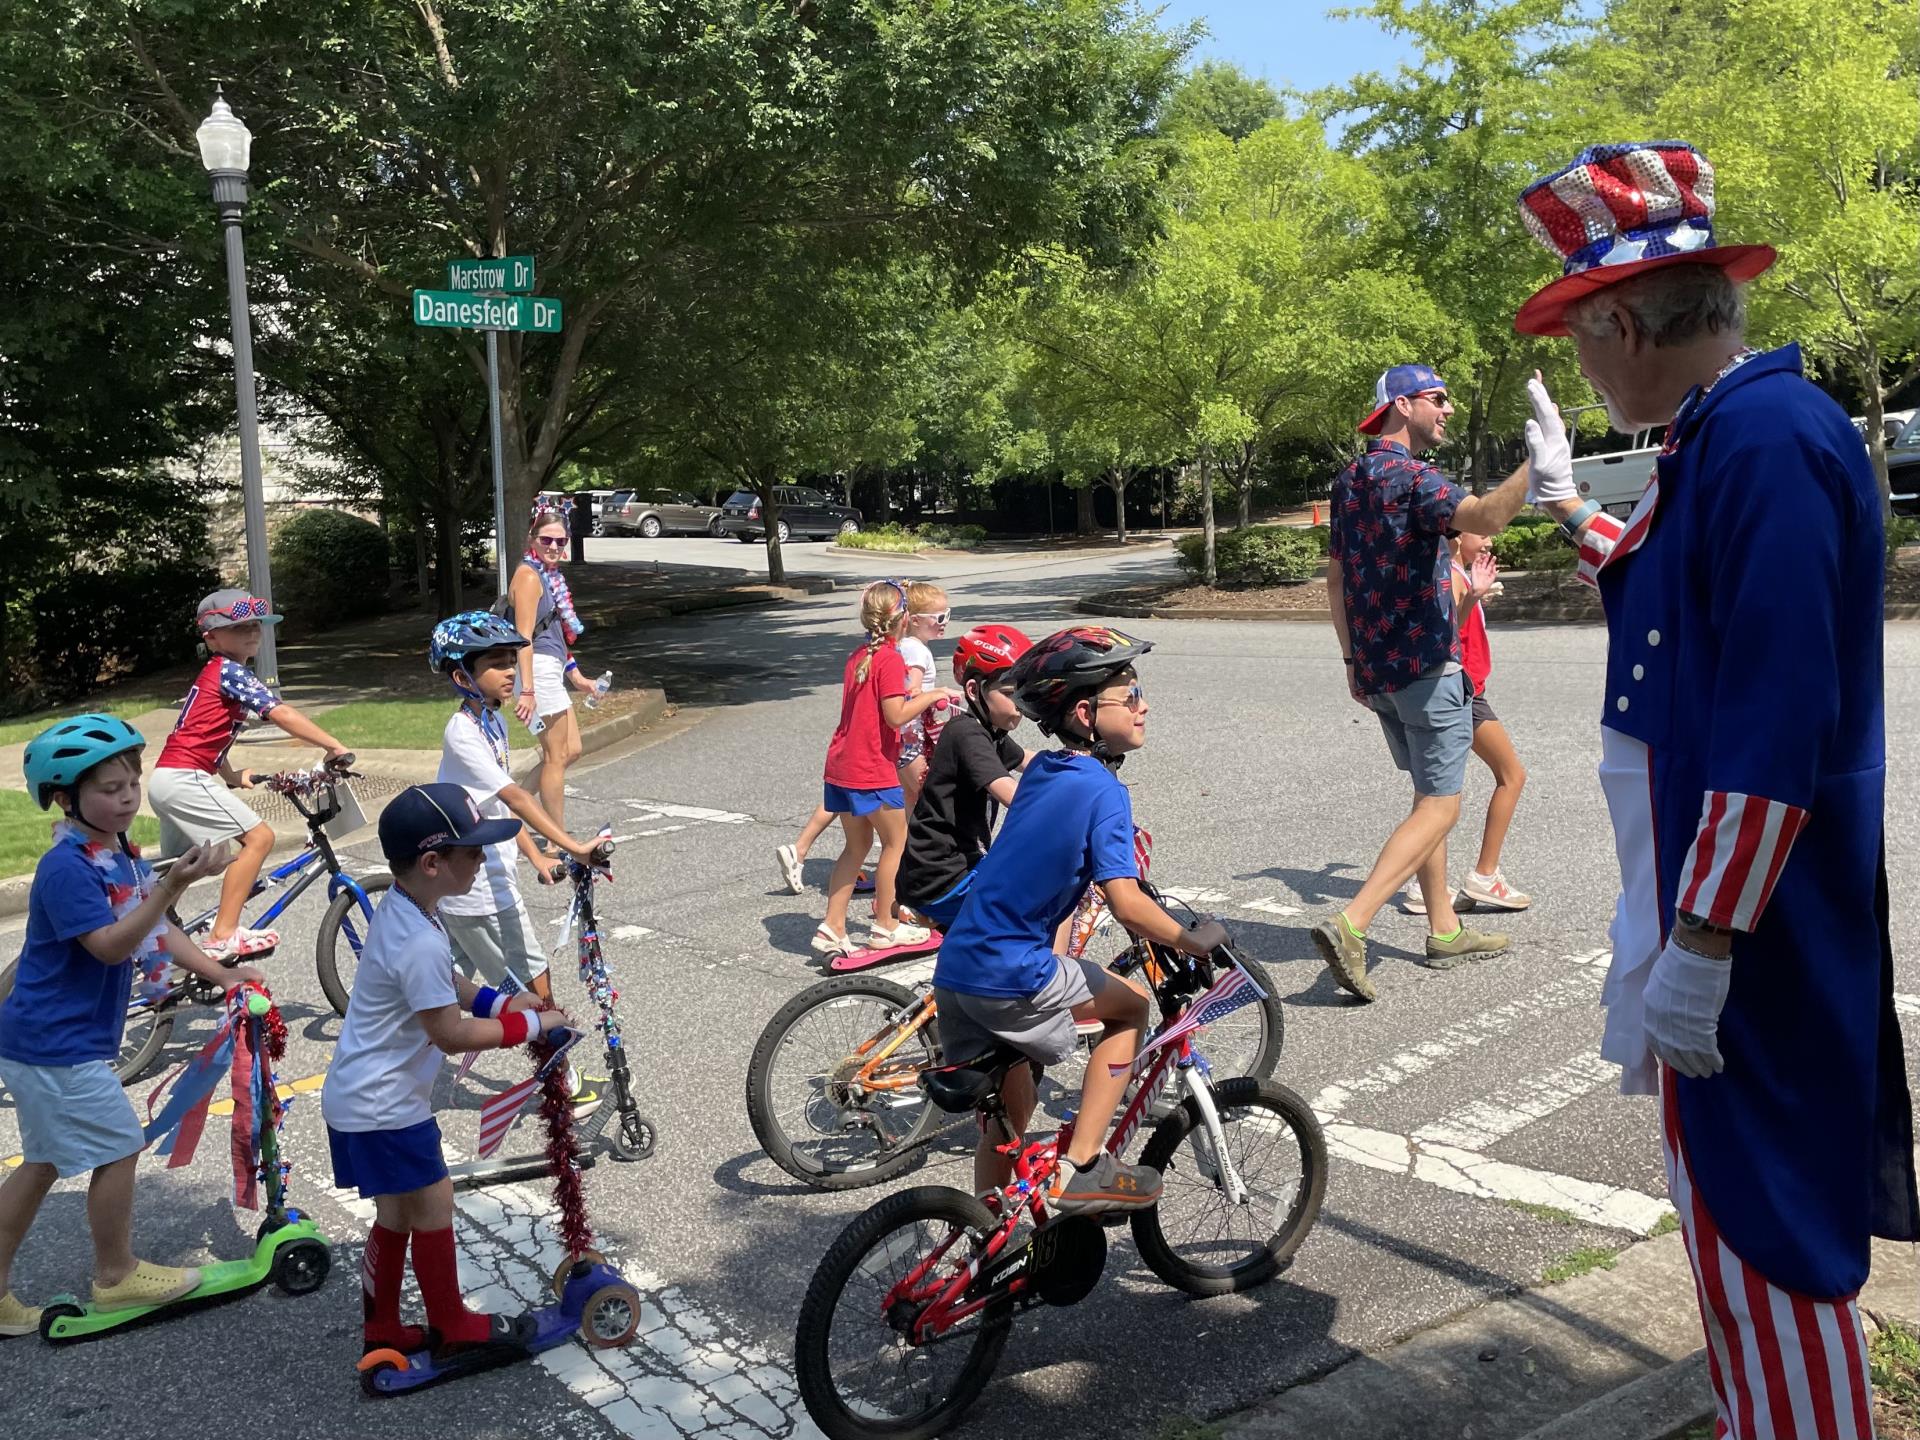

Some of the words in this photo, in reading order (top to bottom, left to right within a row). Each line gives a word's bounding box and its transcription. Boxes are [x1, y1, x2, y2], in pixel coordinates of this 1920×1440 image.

[451, 264, 505, 290] Marstrow
[514, 261, 529, 287] Dr
[419, 294, 518, 326] Danesfeld
[534, 302, 555, 328] Dr
[991, 1255, 1028, 1287] KOEN
